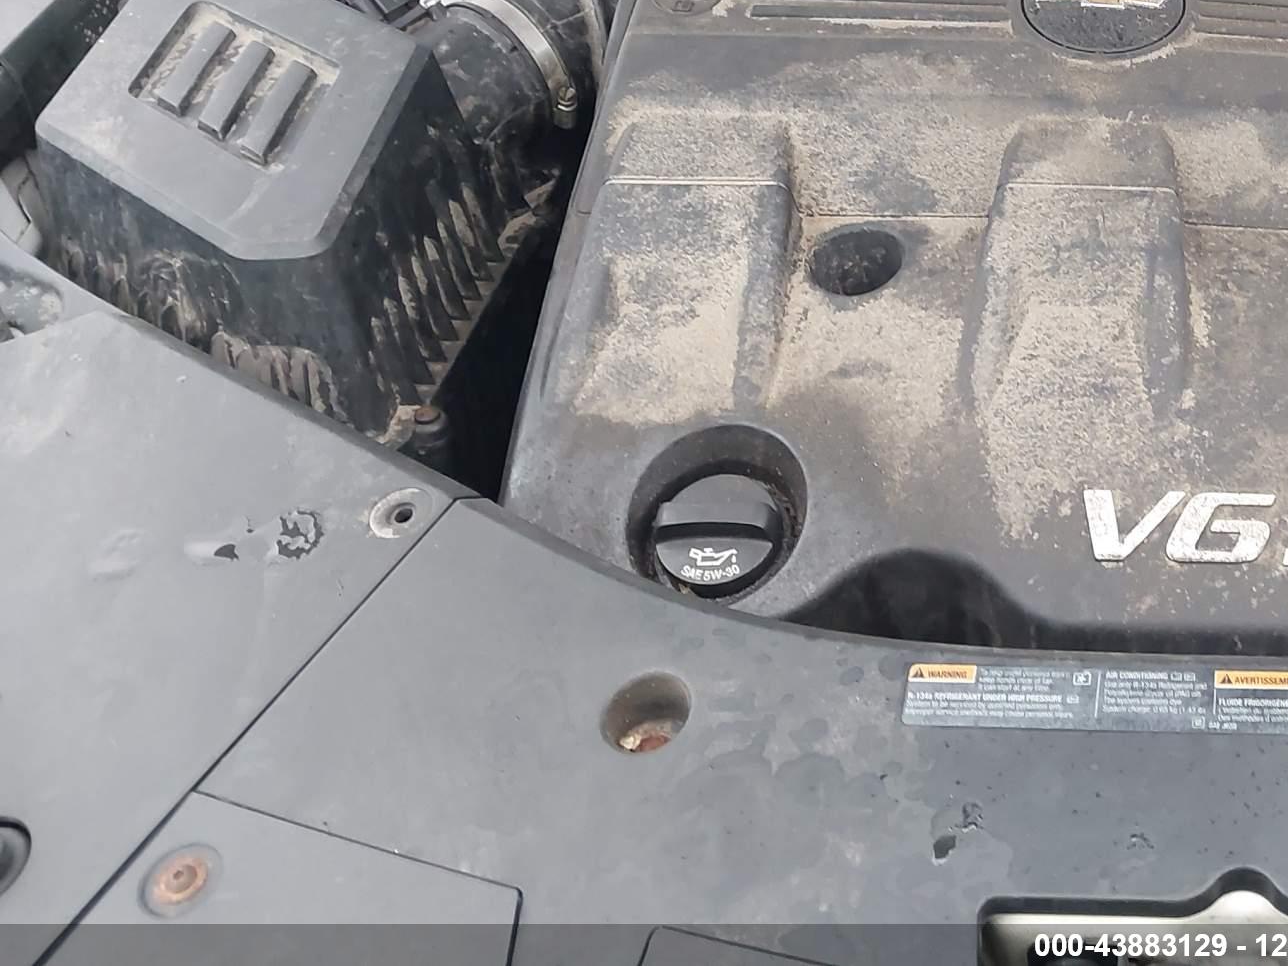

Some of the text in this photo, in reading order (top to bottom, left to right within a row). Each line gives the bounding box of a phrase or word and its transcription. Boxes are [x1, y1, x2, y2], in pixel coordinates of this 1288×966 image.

[1083, 490, 1276, 563] V6
[680, 564, 741, 581] SAE 5W-30
[927, 670, 967, 679] WARNING
